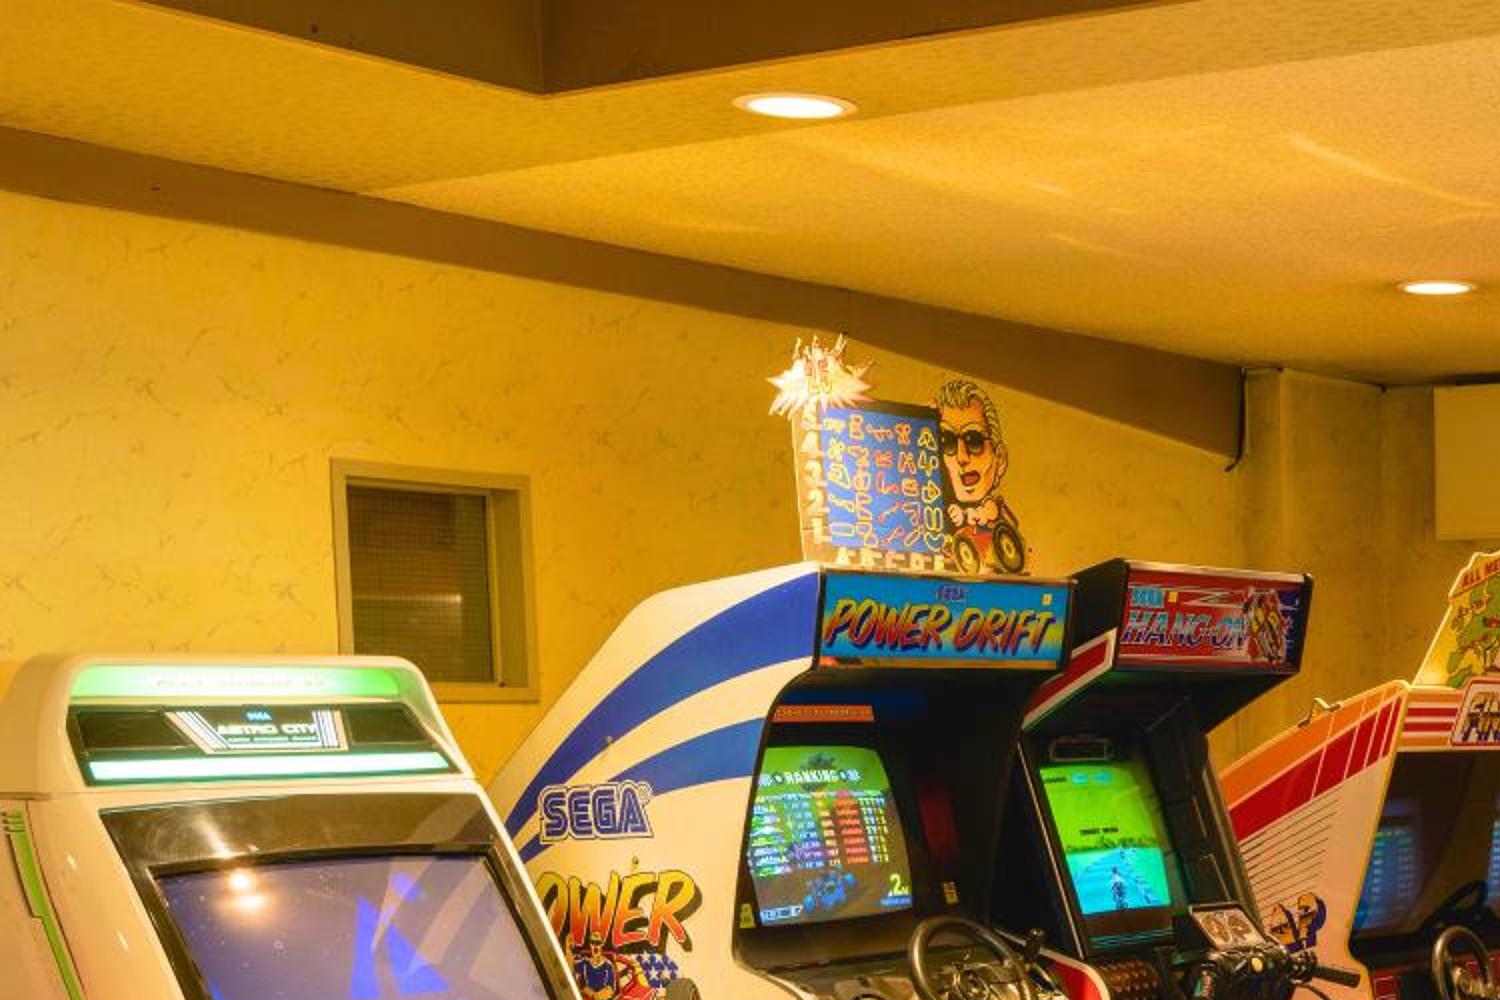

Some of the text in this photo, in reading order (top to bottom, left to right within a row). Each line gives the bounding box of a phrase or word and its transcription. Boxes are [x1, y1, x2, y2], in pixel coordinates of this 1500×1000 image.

[823, 597, 1057, 655] POWER DRIFT
[541, 783, 652, 841] SEGA
